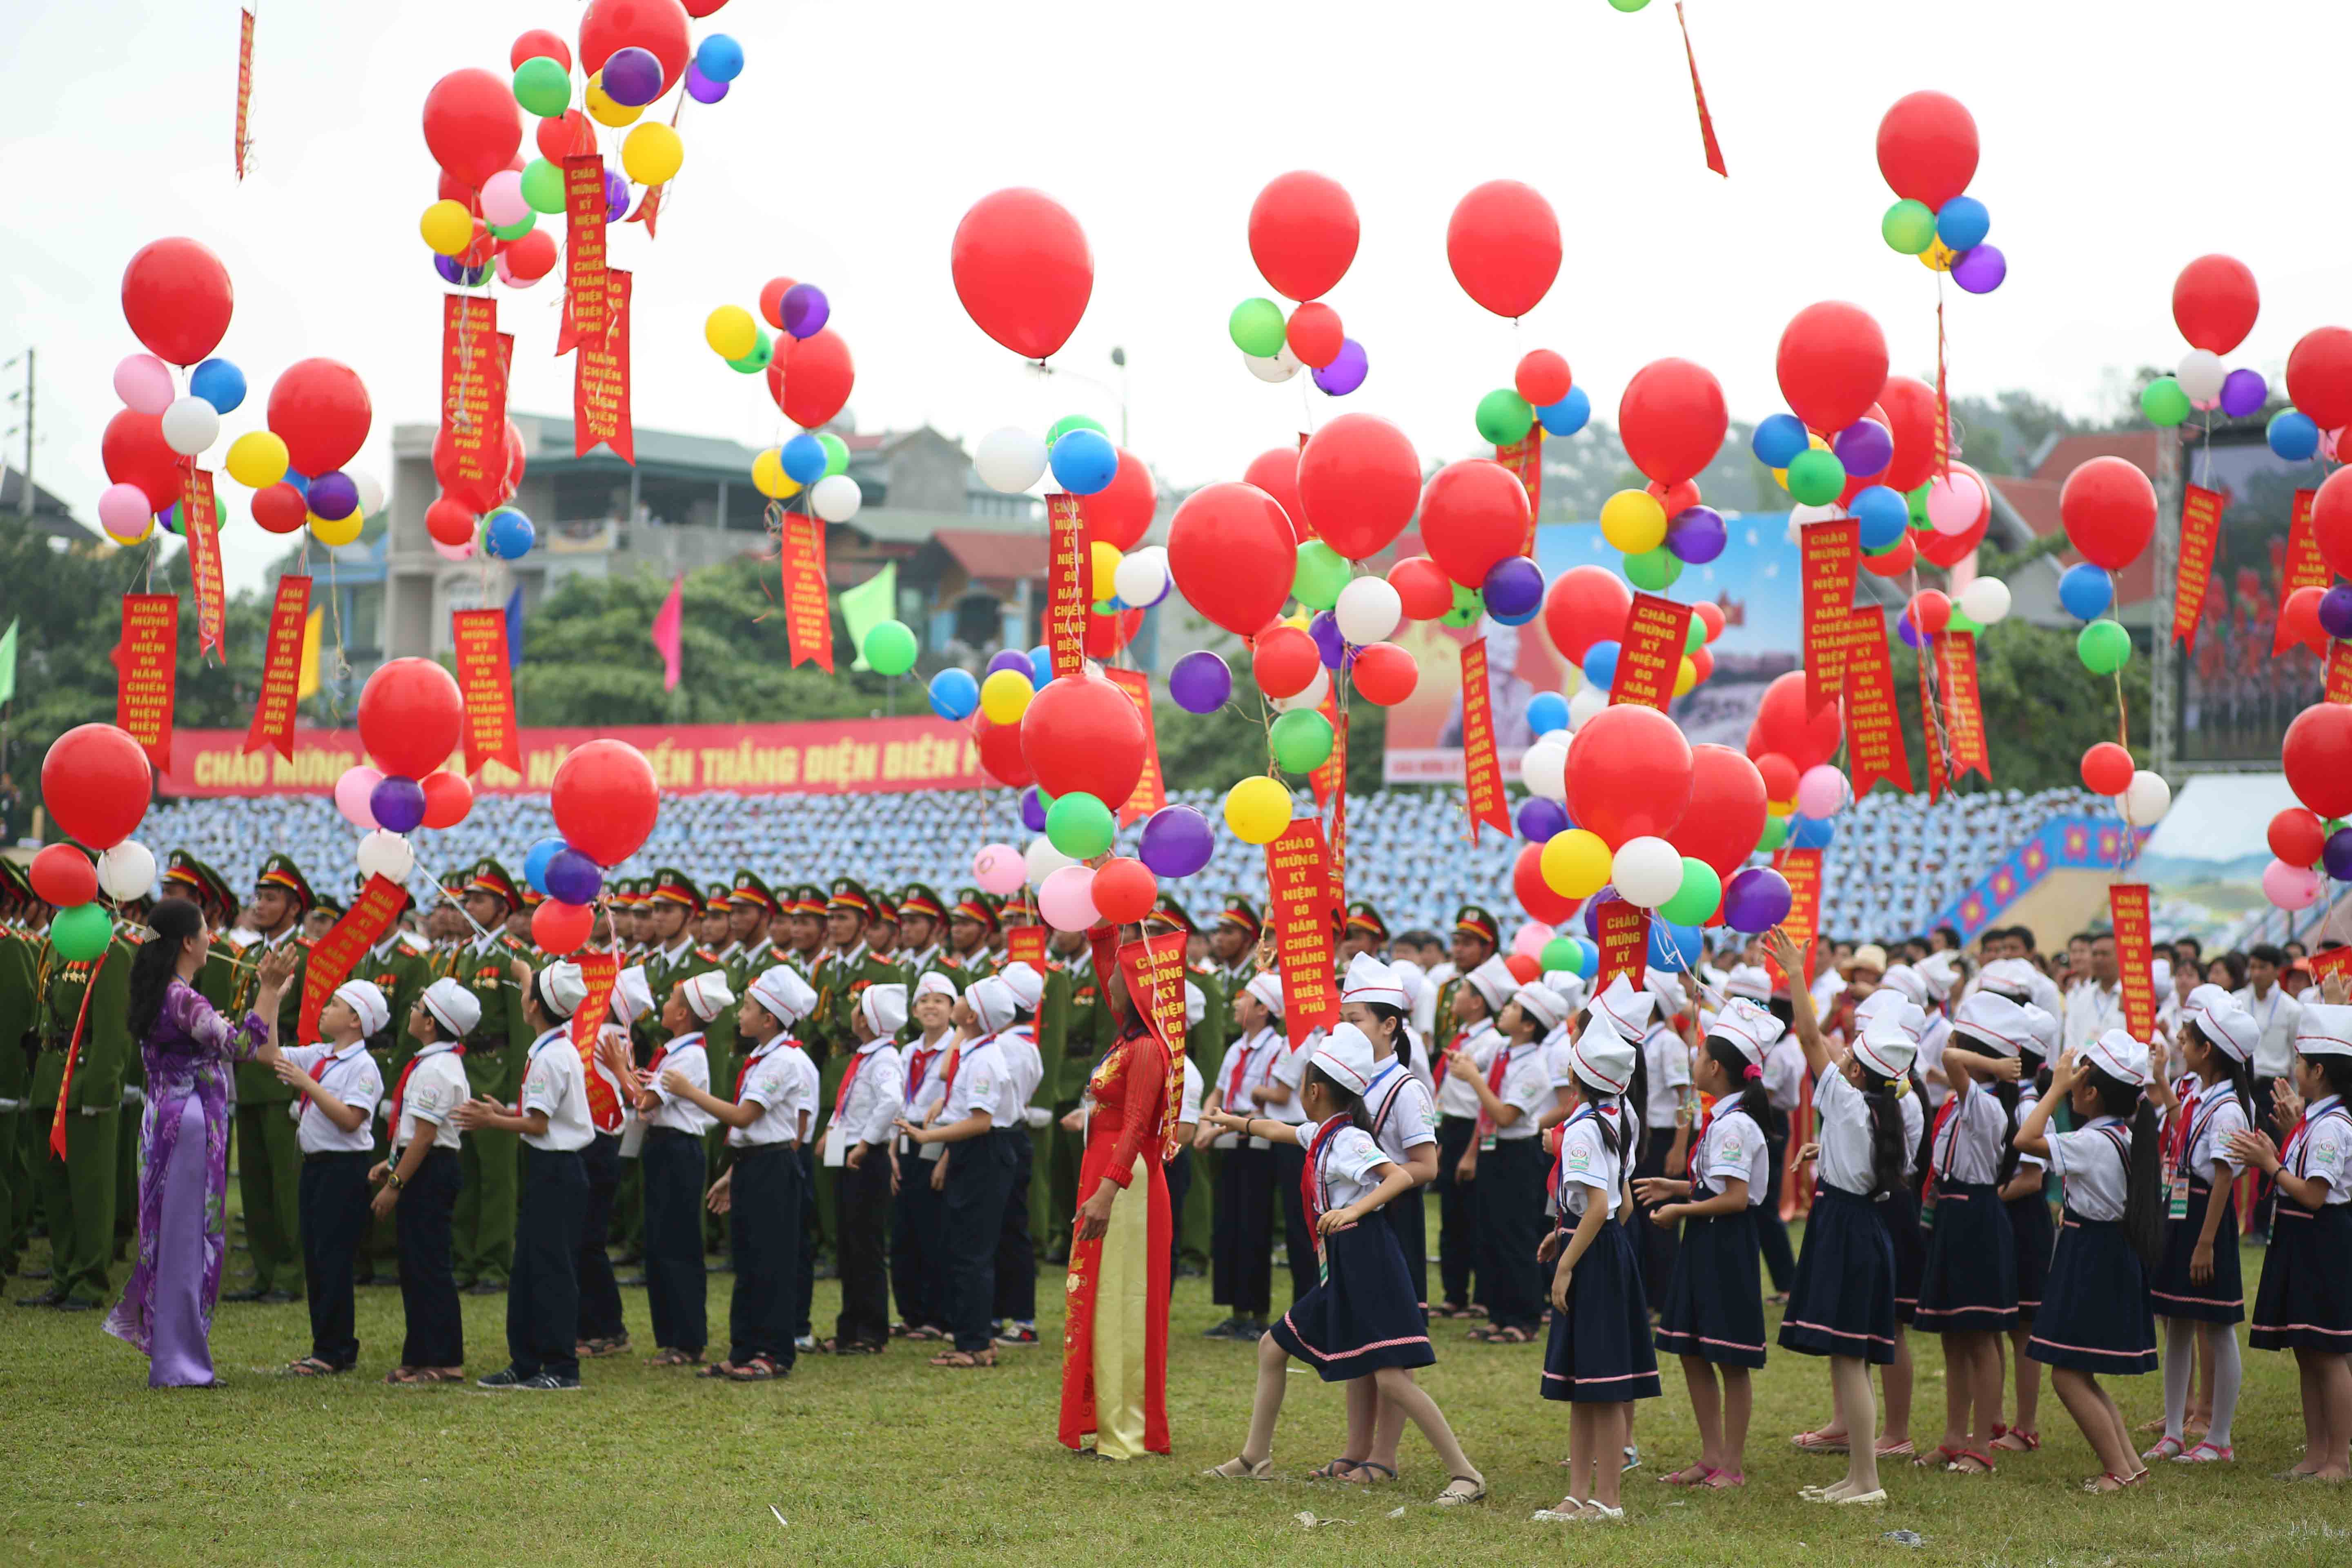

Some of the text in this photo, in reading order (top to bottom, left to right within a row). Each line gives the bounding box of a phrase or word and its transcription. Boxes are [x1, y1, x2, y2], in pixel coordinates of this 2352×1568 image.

[1064, 571, 1077, 582] 60
[1055, 603, 1086, 617] CHIẾN
[1058, 653, 1080, 668] BIÊN
[194, 746, 265, 787] CHÀO
[701, 737, 797, 788] THẮNG
[804, 736, 878, 789] ĐIỆN
[883, 732, 958, 780] BIÊN
[1274, 836, 1316, 852] CHÀO
[1276, 854, 1319, 869] MỪNG
[1290, 866, 1307, 883] KỶ
[1283, 887, 1318, 901] NIỆM
[1294, 904, 1310, 916] 60
[1288, 920, 1318, 933] NĂM
[1607, 913, 1640, 929] CHÀO
[1285, 935, 1324, 951] CHIẾN
[1606, 932, 1641, 947] MỪNG
[1135, 949, 1180, 970] CHÀO
[1285, 951, 1327, 967] THẮNG
[1616, 946, 1630, 963] KỶ
[1292, 969, 1322, 982] ĐIỆN
[1157, 981, 1176, 1000] KỶ
[1294, 985, 1325, 999] BIÊN
[1299, 1001, 1326, 1015] PHỦ
[1166, 1020, 1183, 1035] 60
